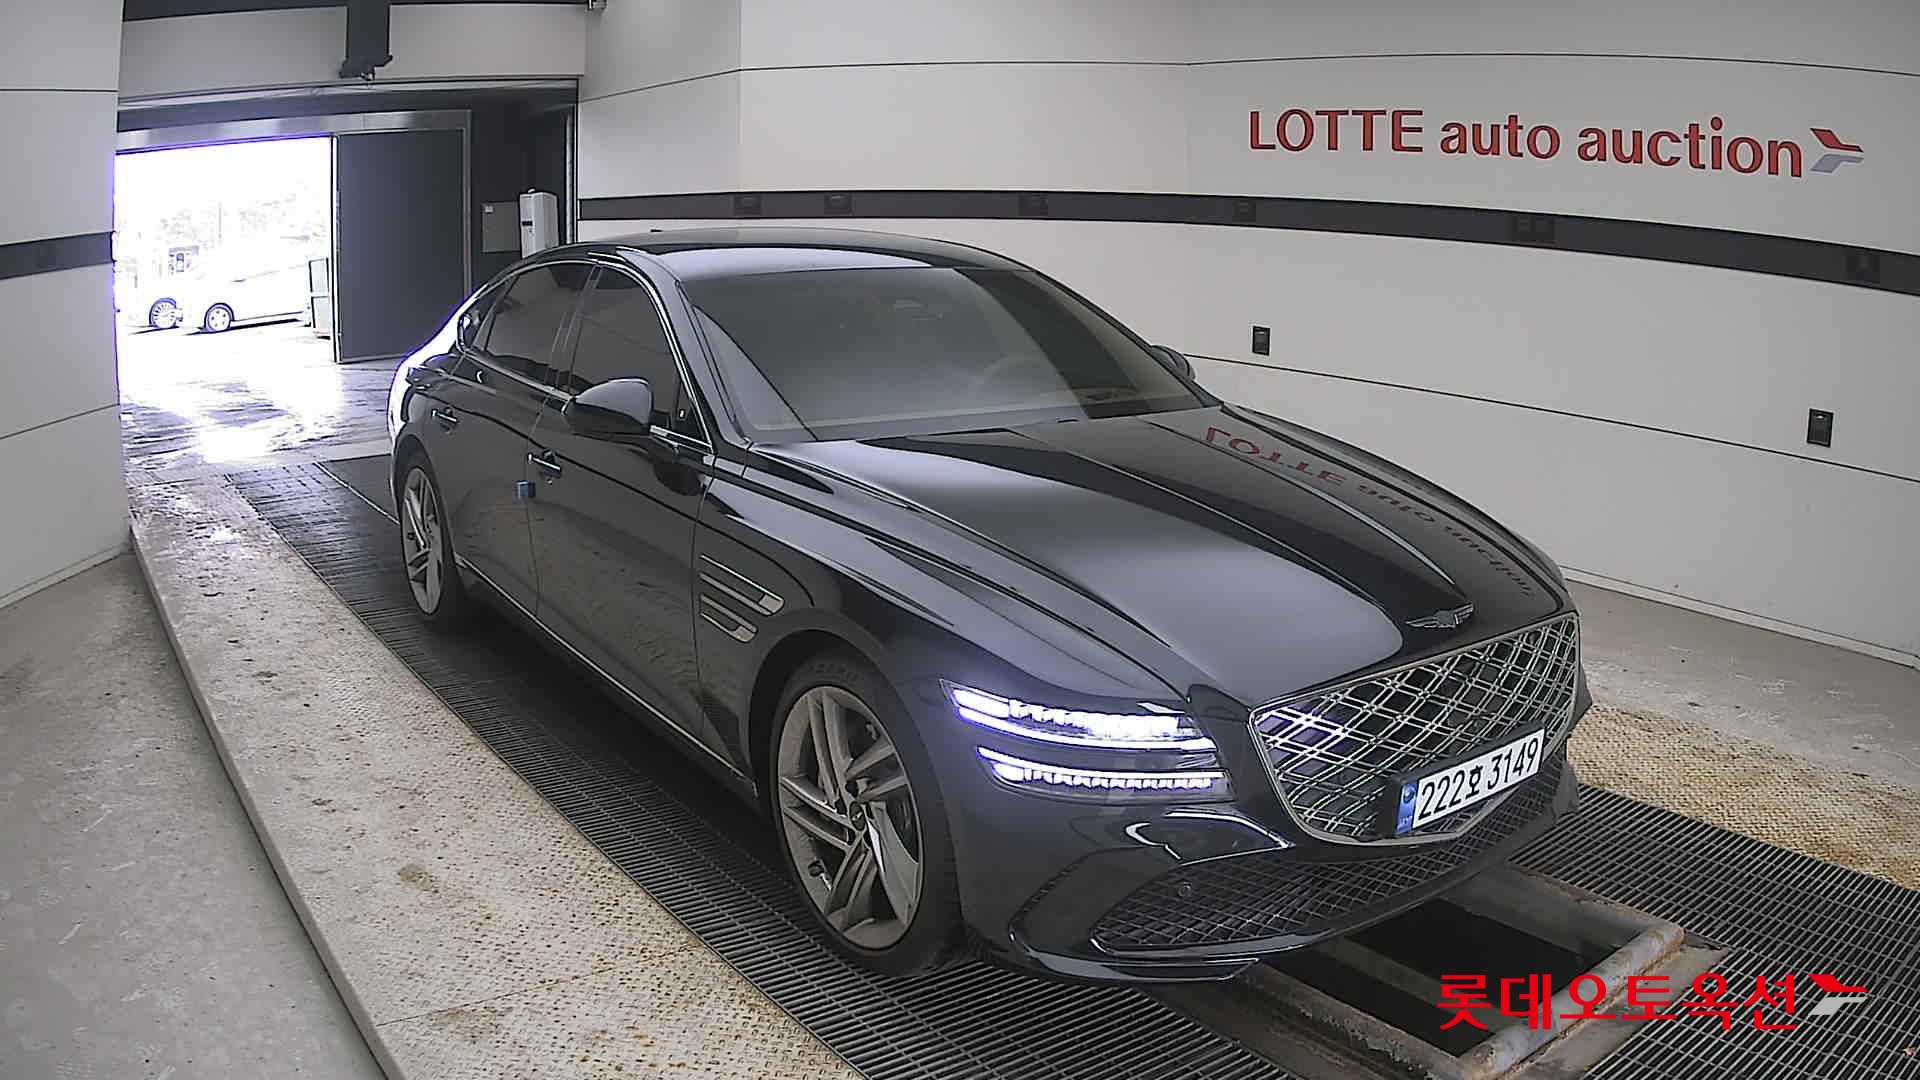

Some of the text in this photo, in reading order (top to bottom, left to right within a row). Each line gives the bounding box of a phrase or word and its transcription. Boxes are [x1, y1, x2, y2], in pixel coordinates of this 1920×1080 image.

[1249, 108, 1803, 178] LOTTE auto auction
[1418, 737, 1539, 821] 222호 3149
